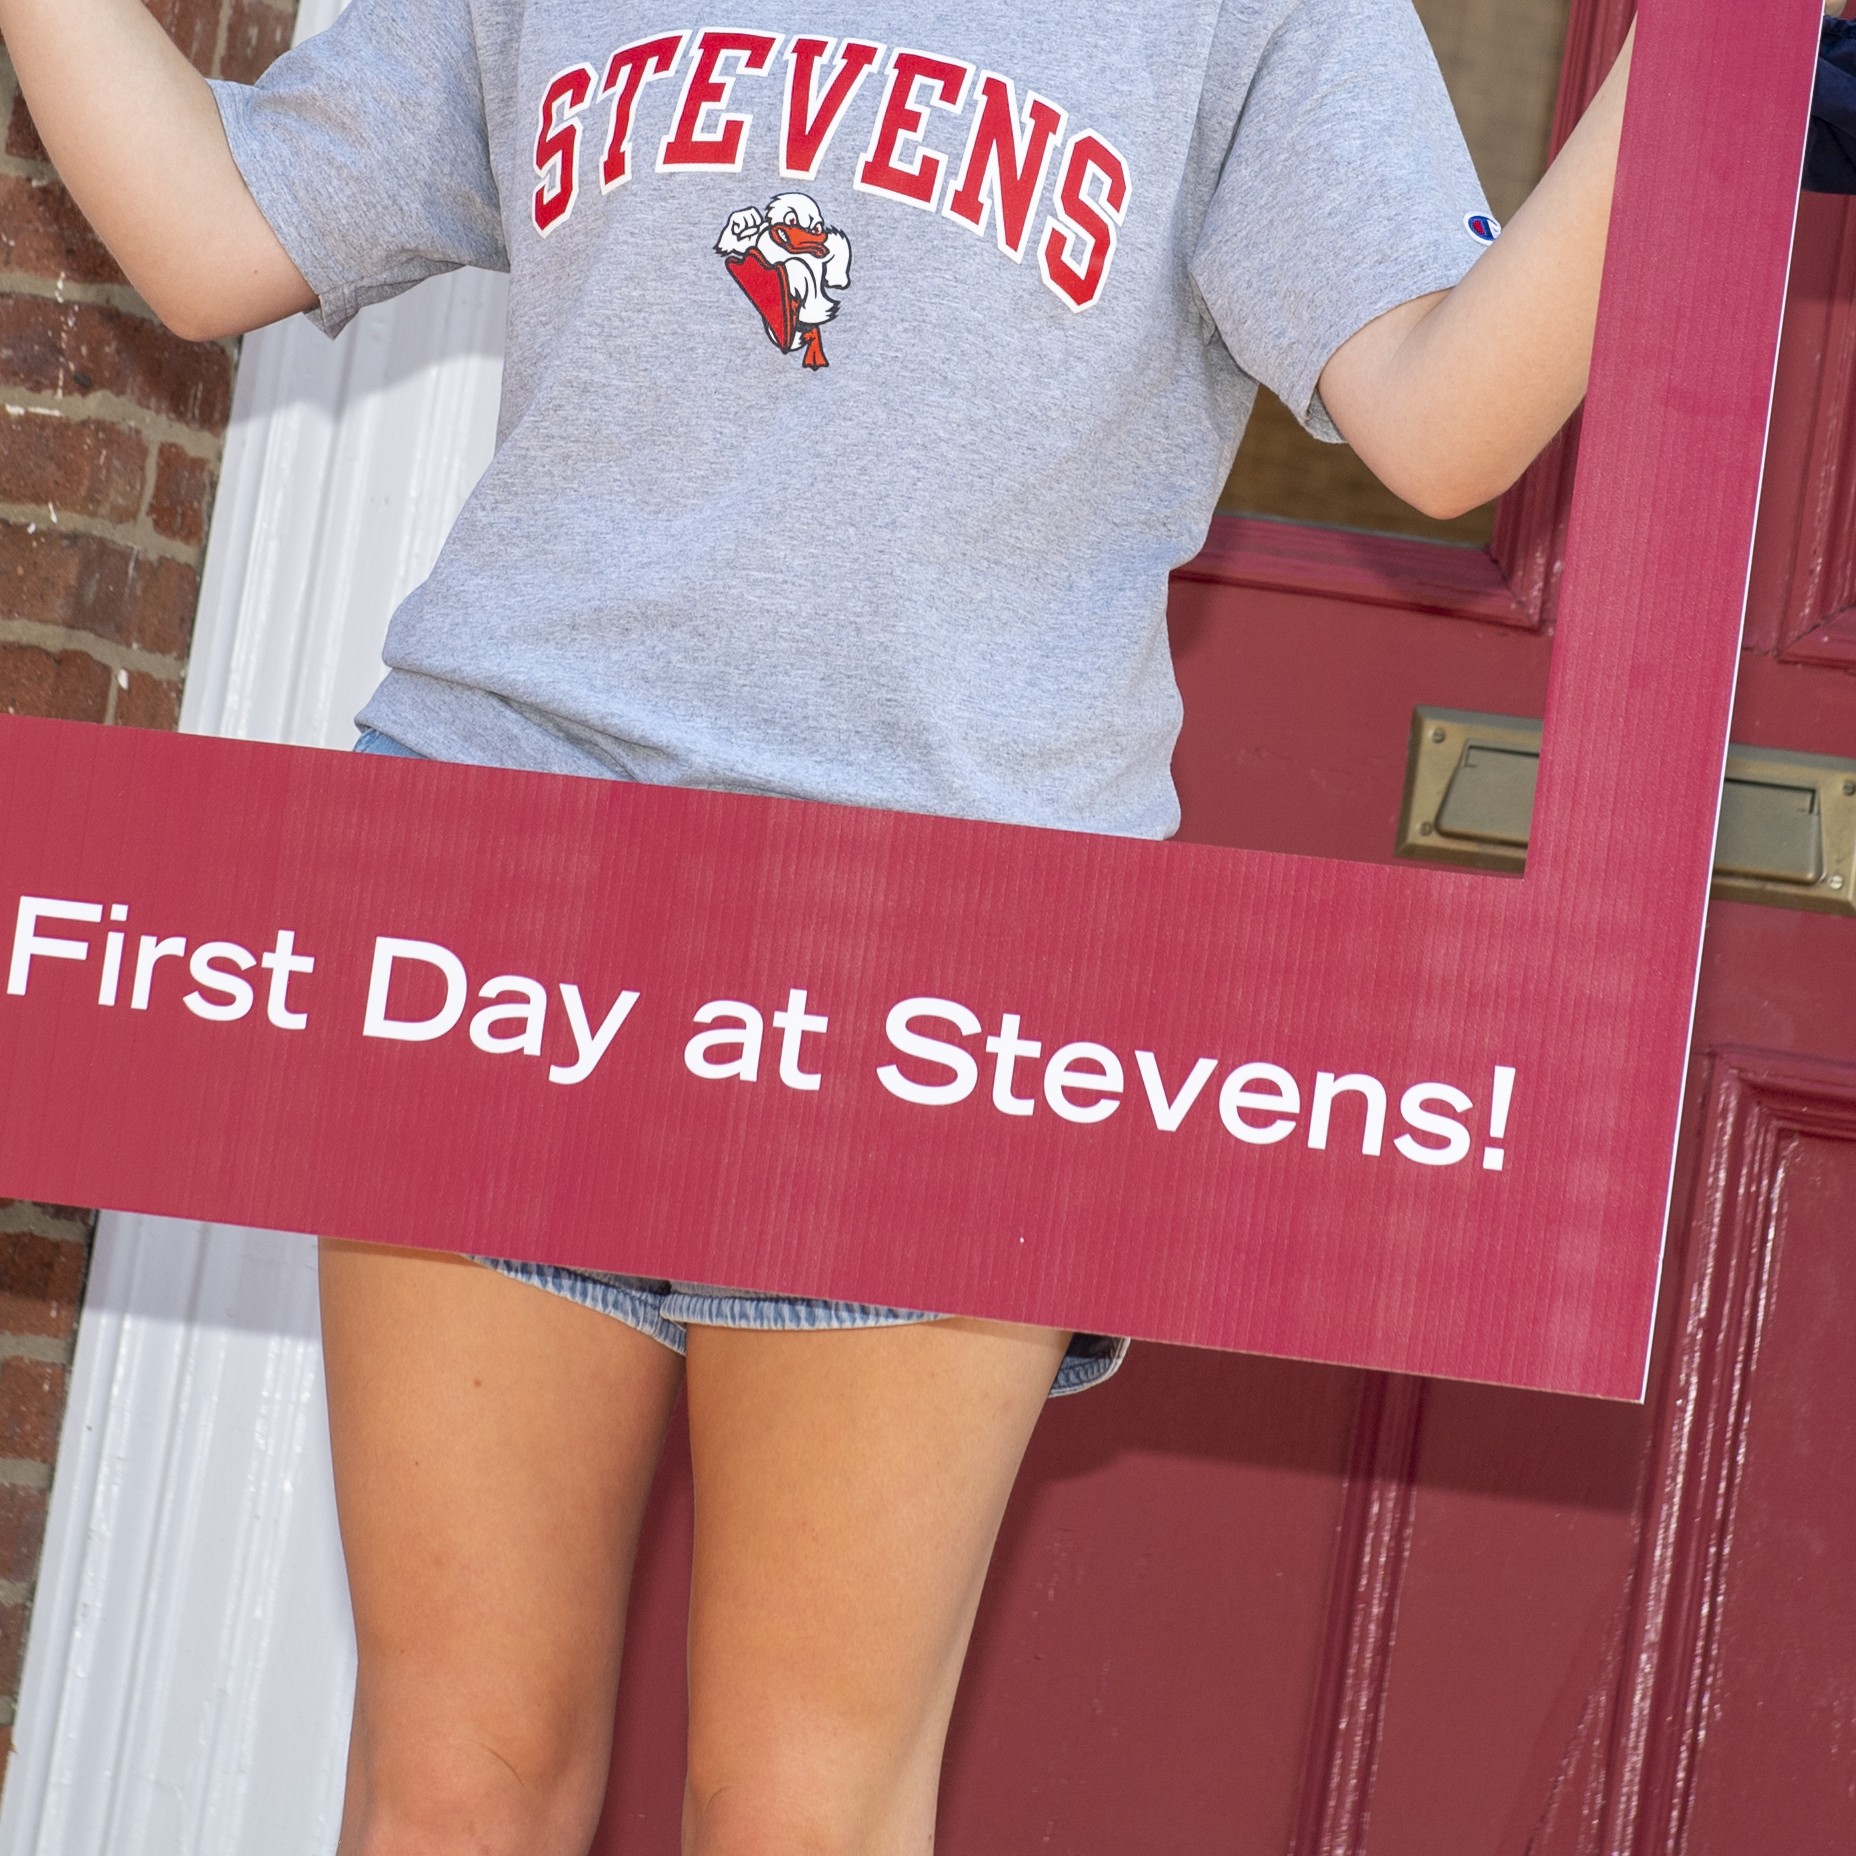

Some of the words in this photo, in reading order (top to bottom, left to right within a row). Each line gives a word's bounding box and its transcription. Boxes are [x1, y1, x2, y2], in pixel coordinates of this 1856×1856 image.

[531, 27, 1133, 314] STEVENS
[6, 895, 315, 1031] First
[362, 936, 641, 1085] Day
[683, 988, 829, 1092] at
[876, 996, 1517, 1172] Stevens!
